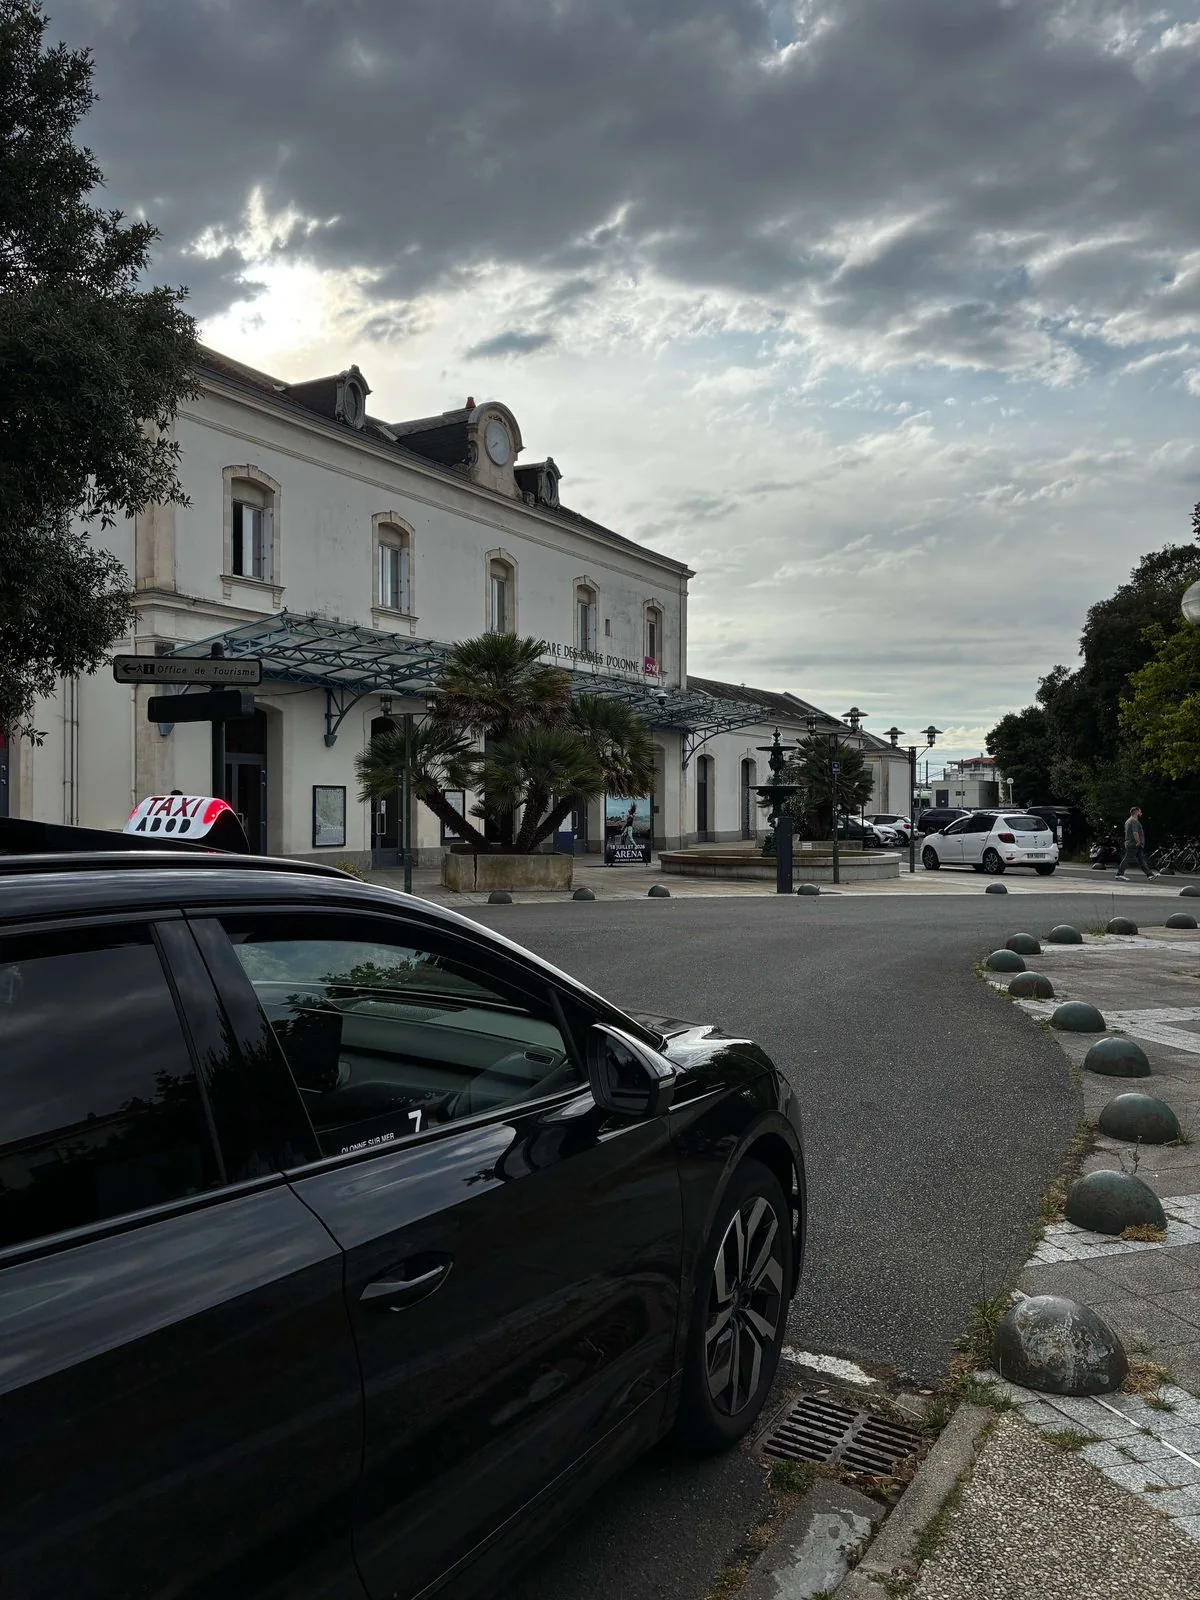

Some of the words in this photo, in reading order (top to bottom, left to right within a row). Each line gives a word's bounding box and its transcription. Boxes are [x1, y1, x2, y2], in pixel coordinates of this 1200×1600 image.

[541, 640, 561, 656] GARE
[564, 645, 578, 659] DES
[580, 650, 603, 665] SABLES
[607, 655, 640, 673] D'OLONNE
[157, 665, 187, 674] Office
[195, 667, 205, 675] de
[213, 667, 255, 676] Tourisme
[146, 797, 205, 818] TAXI
[614, 850, 643, 858] ARENA
[408, 1109, 422, 1133] 7
[367, 1136, 381, 1146] SUR
[381, 1132, 395, 1142] MER
